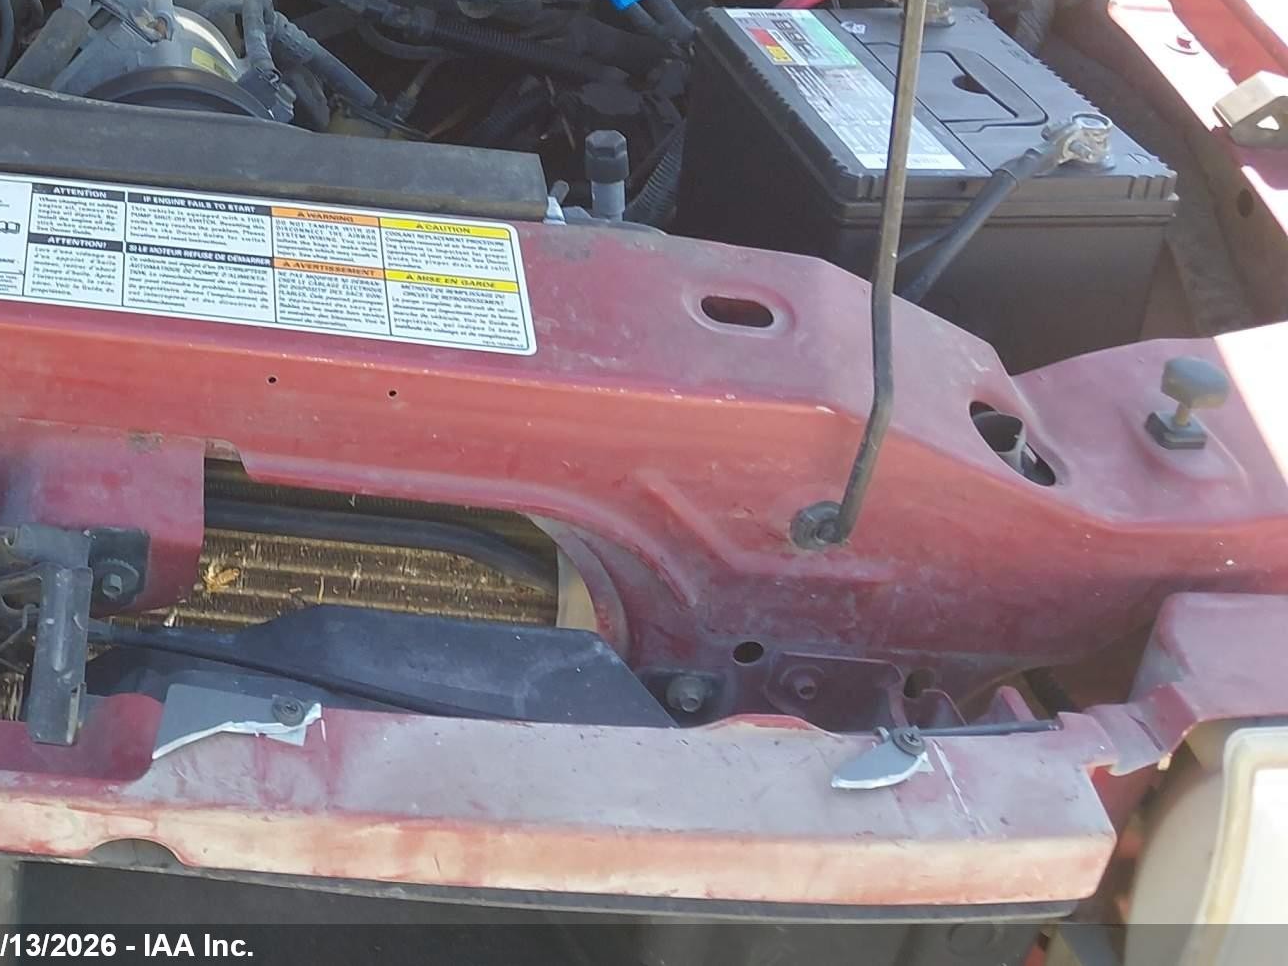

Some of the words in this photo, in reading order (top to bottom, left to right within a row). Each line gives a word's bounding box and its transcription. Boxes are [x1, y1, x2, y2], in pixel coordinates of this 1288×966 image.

[52, 186, 107, 198] ATTENTION
[152, 196, 186, 206] ENGINE
[186, 200, 212, 208] FAILS
[213, 202, 226, 210] TO
[227, 203, 256, 212] START
[306, 212, 354, 222] WARNING
[424, 224, 471, 233] CAUTION
[149, 246, 182, 256] MOTEUR
[292, 262, 374, 275] AVERTISSEMENT
[461, 279, 495, 288] GARDE
